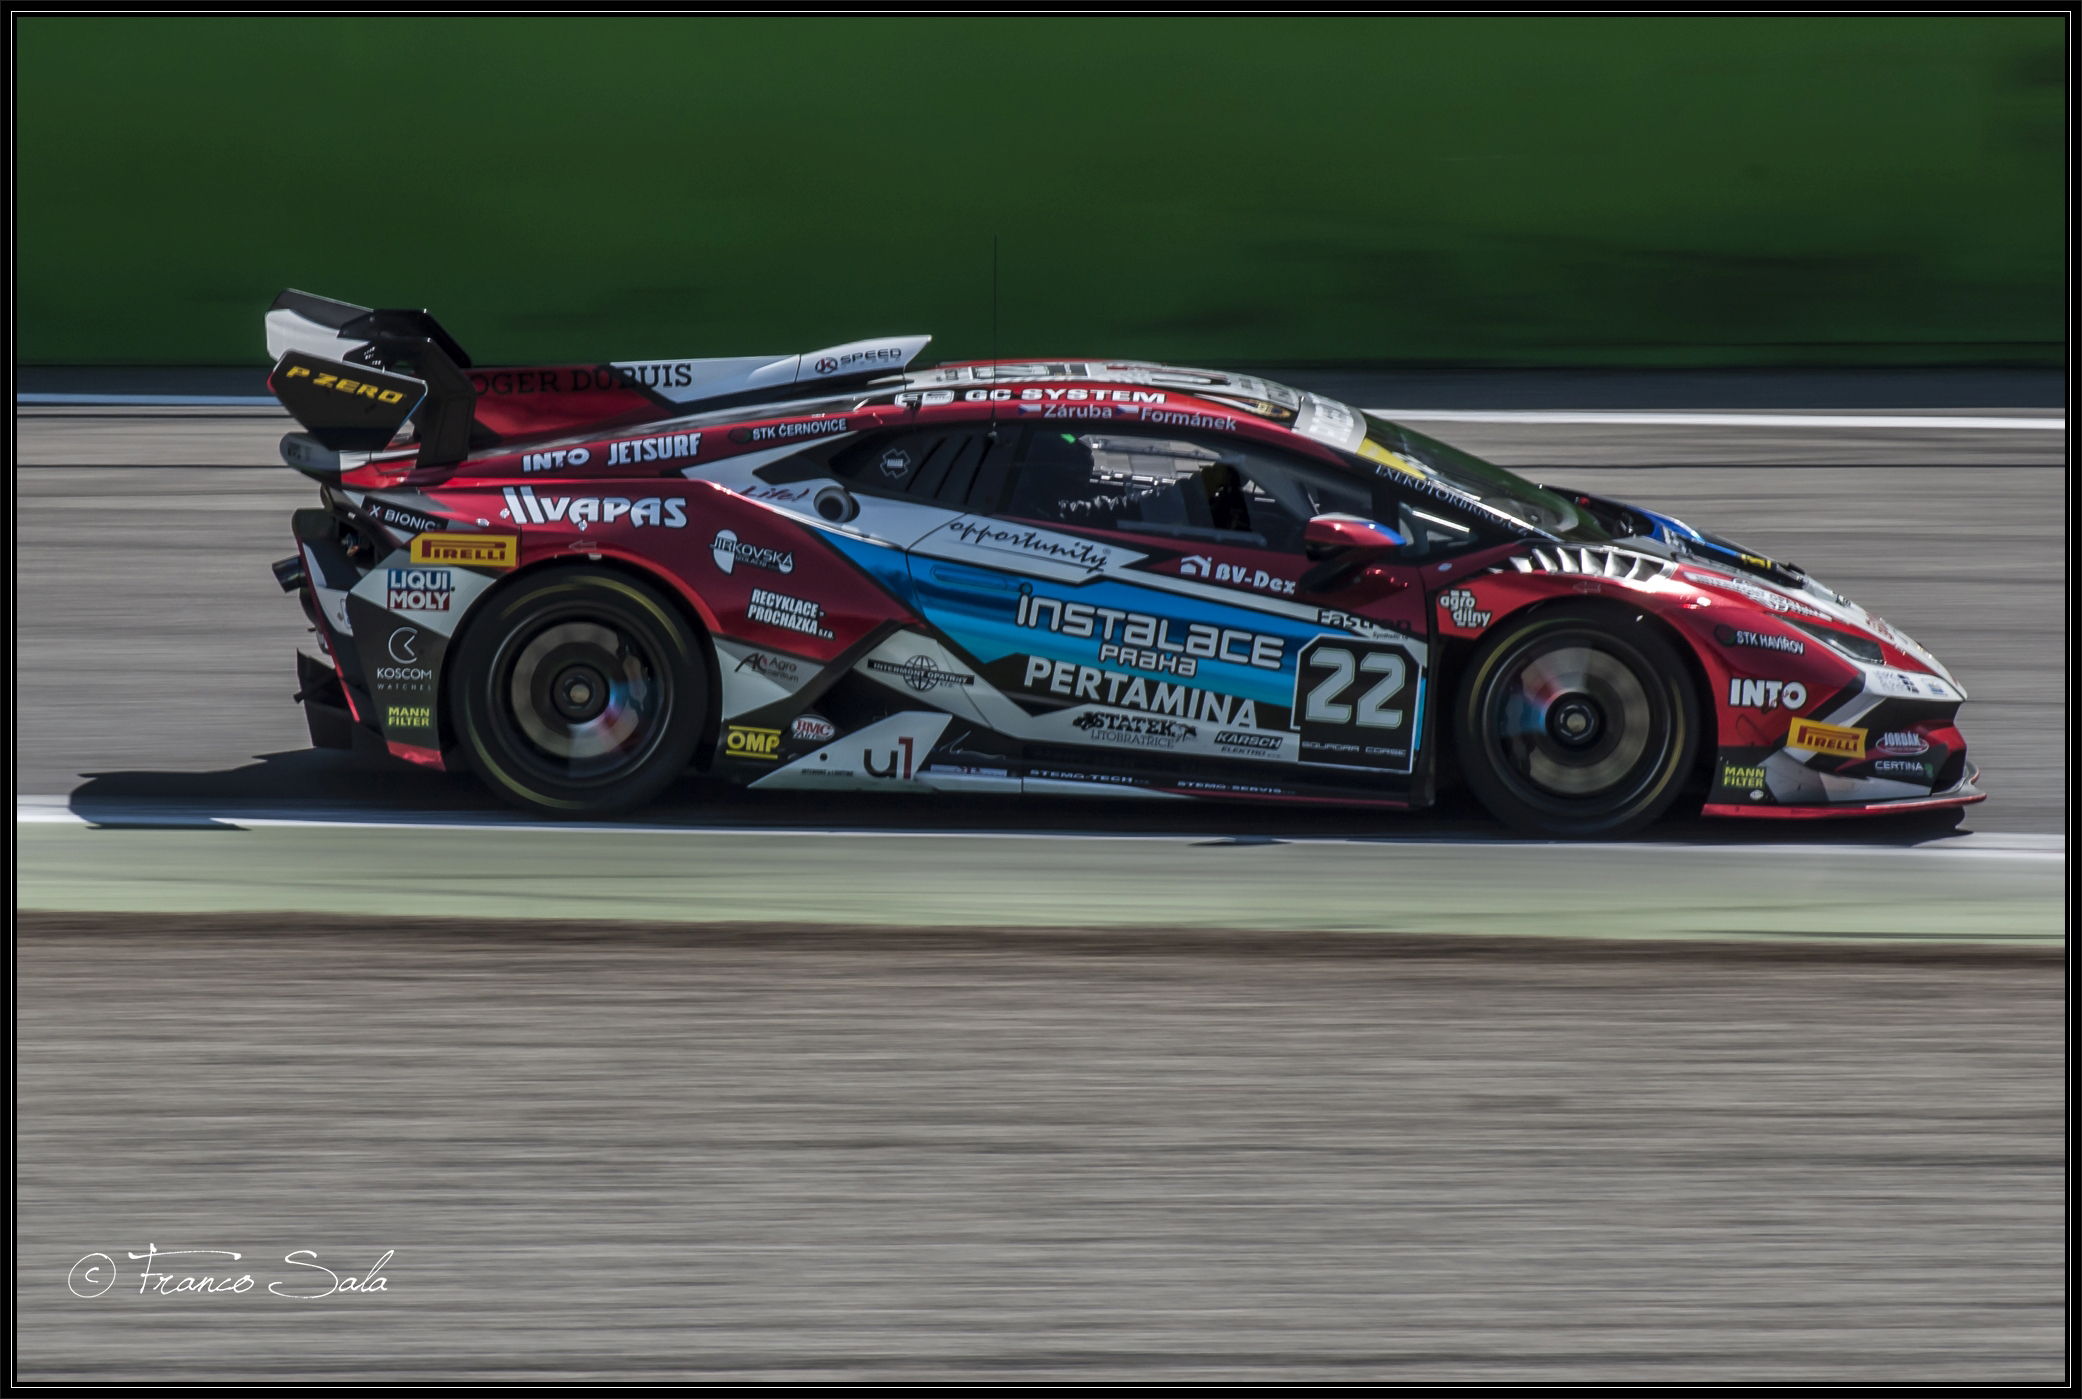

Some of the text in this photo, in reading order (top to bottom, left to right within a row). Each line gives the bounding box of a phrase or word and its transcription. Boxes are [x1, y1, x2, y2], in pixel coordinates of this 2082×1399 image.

[840, 348, 902, 363] SPEED
[286, 365, 403, 404] P ZERO
[965, 389, 1011, 402] GC
[1021, 388, 1167, 404] SYSTEM
[1044, 403, 1112, 419] Záruba
[1140, 407, 1237, 431] Formánek
[752, 418, 847, 441] STK ČERNOVICE
[523, 447, 590, 473] INTO
[607, 432, 702, 467] JETSURF
[369, 504, 437, 531] X BIONIC
[422, 540, 506, 561] PIRELLI
[710, 538, 793, 567] JIRKOVSKÁ
[950, 521, 1107, 573] opportunity
[390, 570, 448, 590] LIQUI
[1215, 563, 1296, 595] BV-Dex
[390, 591, 449, 610] MOLY
[752, 588, 819, 619] RECYKLACE
[1441, 590, 1475, 611] agro
[748, 603, 818, 635] PROCHÁZKA
[1737, 630, 1758, 646] STK
[377, 668, 431, 680] KOSCOM
[769, 656, 797, 672] Agro
[873, 662, 968, 684] INTERMONT OPATRNÝ
[377, 683, 432, 691] WATCHES
[1023, 656, 1257, 730] PERTAMINA
[1305, 647, 1406, 730] 22
[1730, 678, 1807, 709] INTO
[388, 706, 430, 717] MANN
[388, 717, 430, 727] FILTER
[796, 718, 833, 736] BMC
[727, 730, 780, 753] OMP
[1091, 730, 1174, 752] LITOBRATRICE
[1217, 732, 1282, 748] KARSCH
[1797, 725, 1859, 753] PIRELLI
[1884, 731, 1921, 747] JORDÁK
[1221, 746, 1265, 757] ELEKTRO
[1725, 766, 1765, 778] MANN
[1875, 760, 1923, 772] CERTINA
[1724, 776, 1763, 788] FILTER
